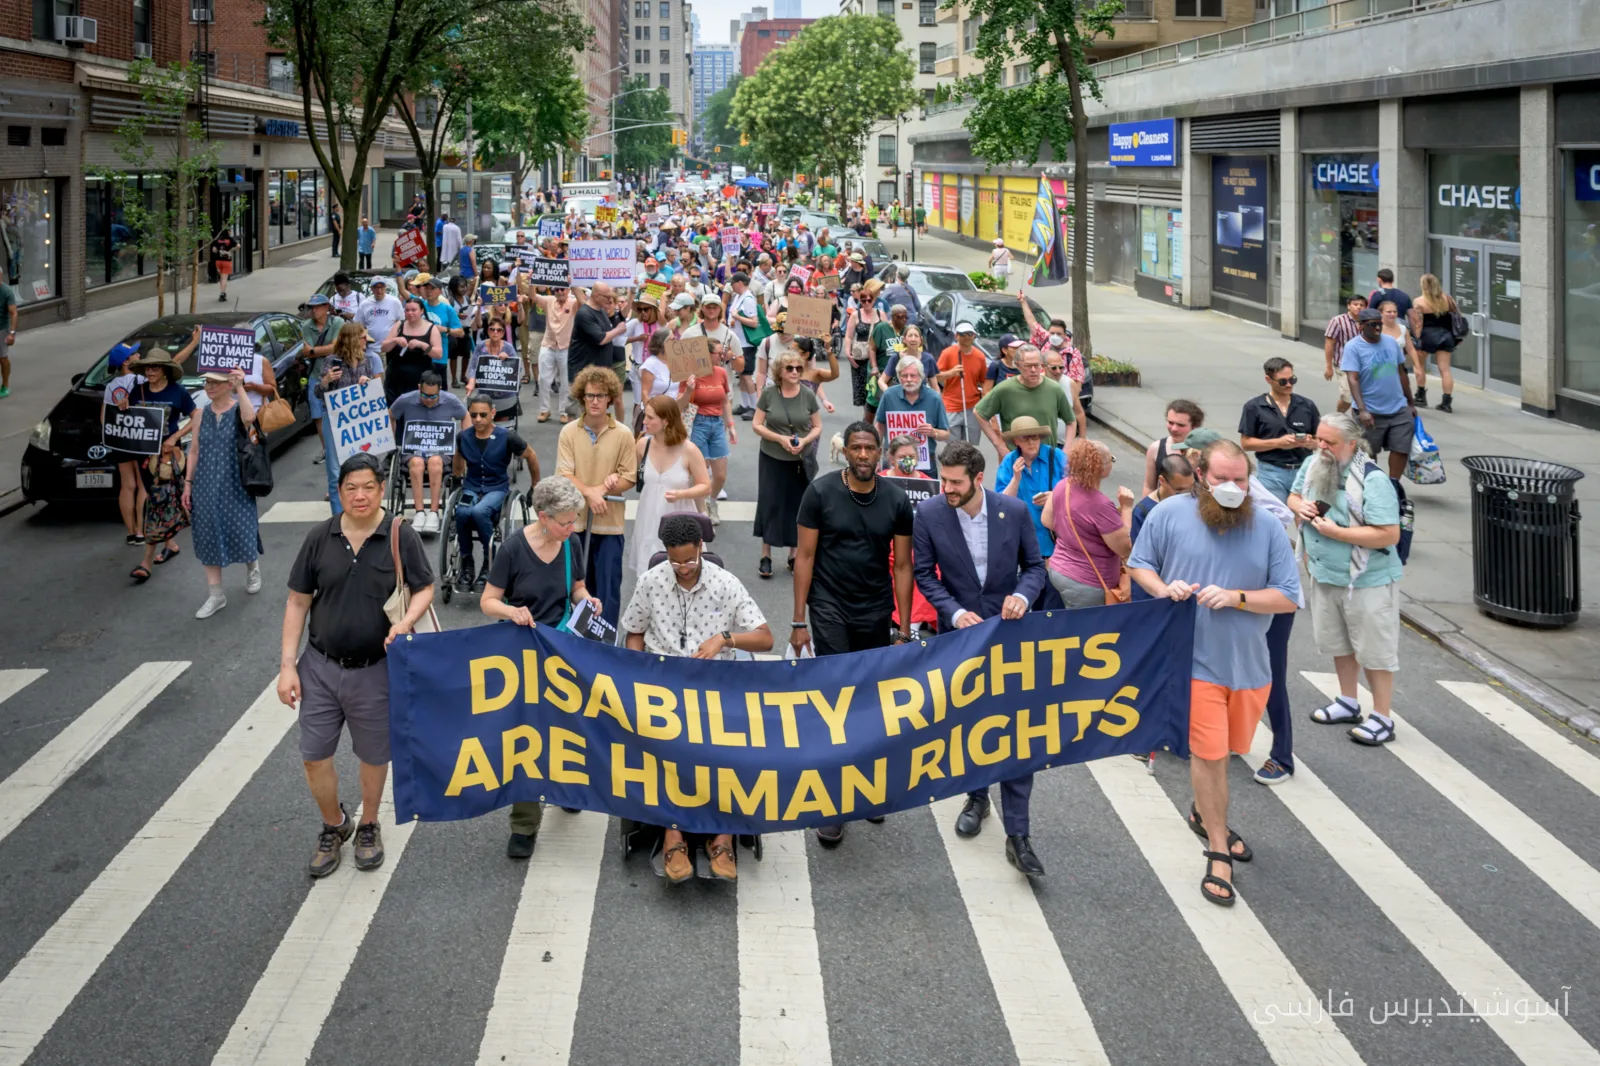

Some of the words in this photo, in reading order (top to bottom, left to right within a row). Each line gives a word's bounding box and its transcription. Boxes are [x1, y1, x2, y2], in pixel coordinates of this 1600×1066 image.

[1112, 132, 1133, 149] Happy
[1139, 131, 1169, 145] Cleaners
[1317, 163, 1369, 184] CHASE
[1438, 184, 1511, 209] CHASE
[722, 227, 739, 237] HANDS
[570, 248, 596, 259] IMAGINE
[597, 248, 602, 259] A
[605, 247, 630, 259] WORLD
[534, 261, 549, 269] THE
[572, 268, 600, 278] WITHOUT
[602, 268, 631, 278] BARRIERS
[35, 285, 49, 297] SALE
[486, 287, 510, 296] ADA
[369, 307, 389, 316] cidny
[202, 331, 229, 345] HATE
[230, 334, 254, 347] WILL
[201, 344, 224, 356] NOT
[225, 345, 253, 358] MAKE
[201, 355, 216, 367] US
[217, 356, 253, 371] GREAT
[479, 365, 514, 374] DEMAND
[489, 359, 502, 367] WE
[484, 372, 506, 381] 100%
[328, 382, 368, 411] KEEP
[337, 396, 388, 429] ACCESS
[115, 413, 146, 428] FOR
[888, 413, 925, 428] HANDS
[104, 423, 159, 441] SHAME!
[340, 414, 389, 447] ALIVE!
[407, 424, 453, 433] DISABILITY
[414, 432, 445, 440] RIGHTS
[420, 438, 437, 446] ARE
[471, 650, 855, 748] DISABILITY
[878, 633, 1121, 737] RIGHTS
[445, 725, 590, 797] ARE
[611, 744, 887, 821] HUMAN
[910, 685, 1140, 789] RIGHTS
